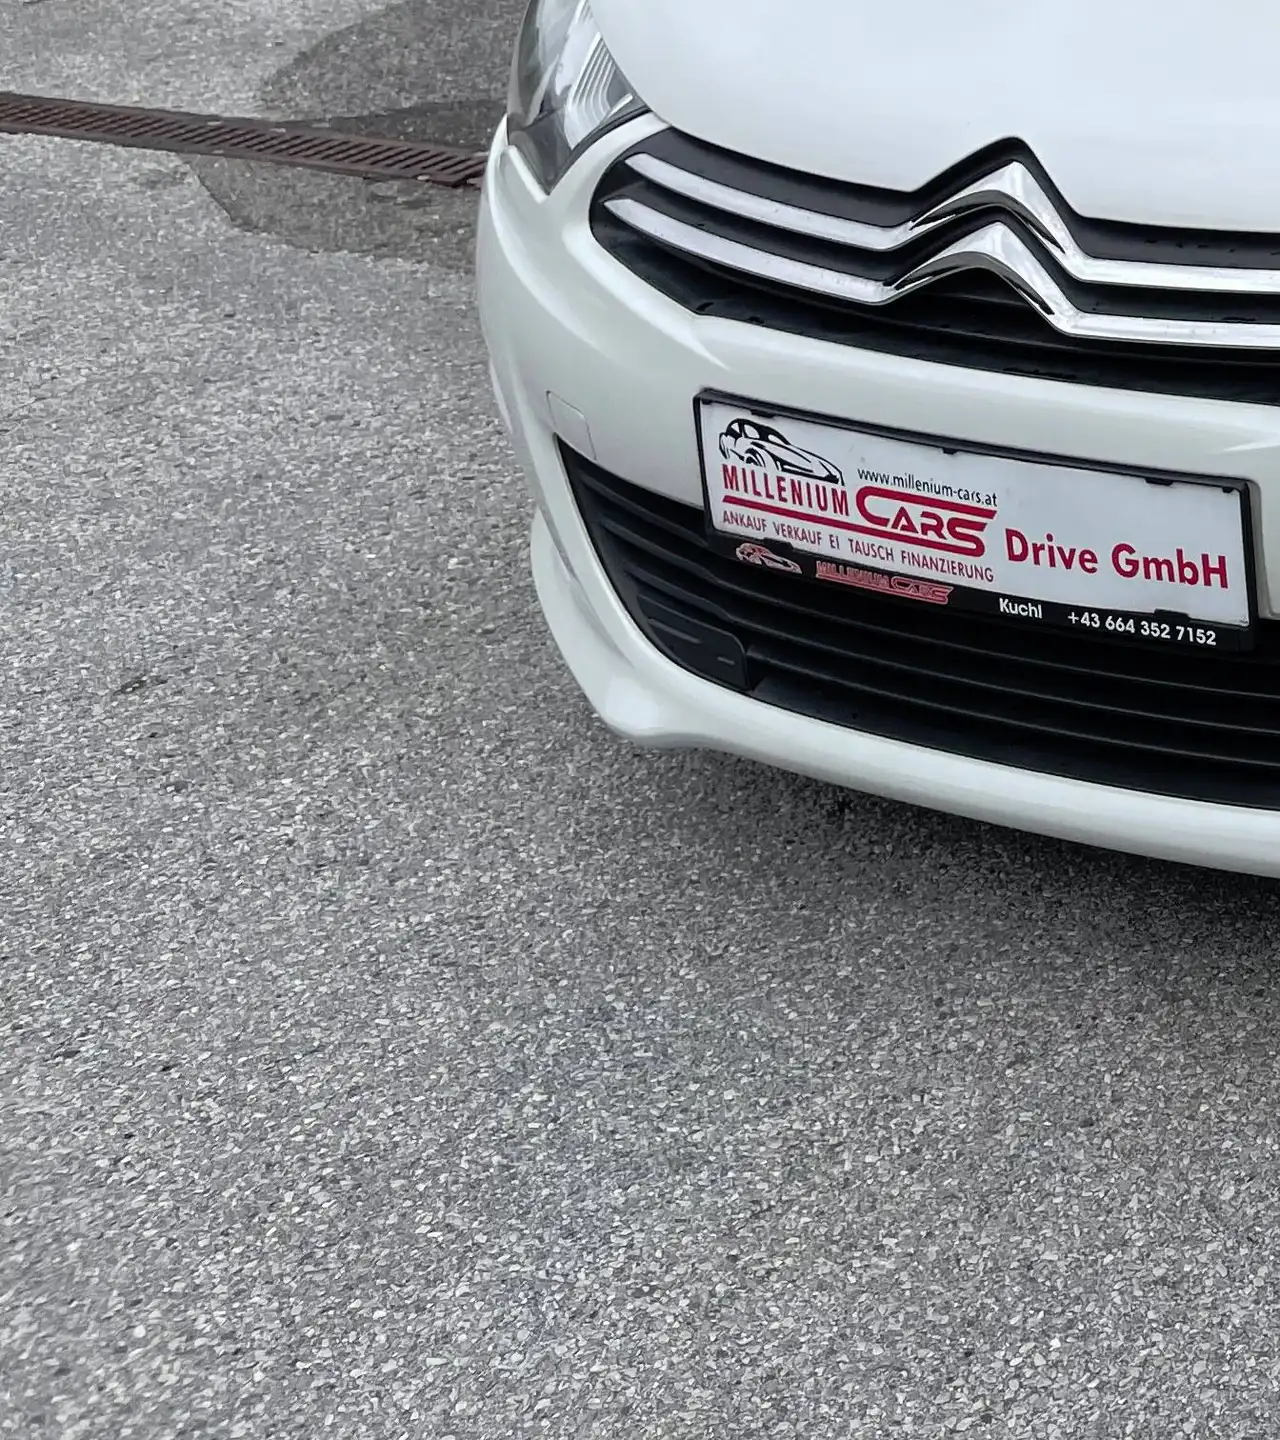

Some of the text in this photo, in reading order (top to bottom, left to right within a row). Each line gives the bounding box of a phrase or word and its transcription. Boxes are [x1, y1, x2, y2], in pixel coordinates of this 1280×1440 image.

[856, 467, 998, 508] www.millenium-cars.at
[721, 463, 1229, 589] MILLENIUM CARS Drive GmbH
[722, 510, 768, 533] ANKAUF
[772, 520, 823, 546] VERKAUF
[901, 549, 995, 583] FINANZIERUNG
[999, 597, 1043, 619] Kuchl
[1067, 611, 1100, 628] +43
[1105, 615, 1136, 633] 664
[1140, 620, 1171, 639] 352
[1175, 625, 1217, 646] 7152
